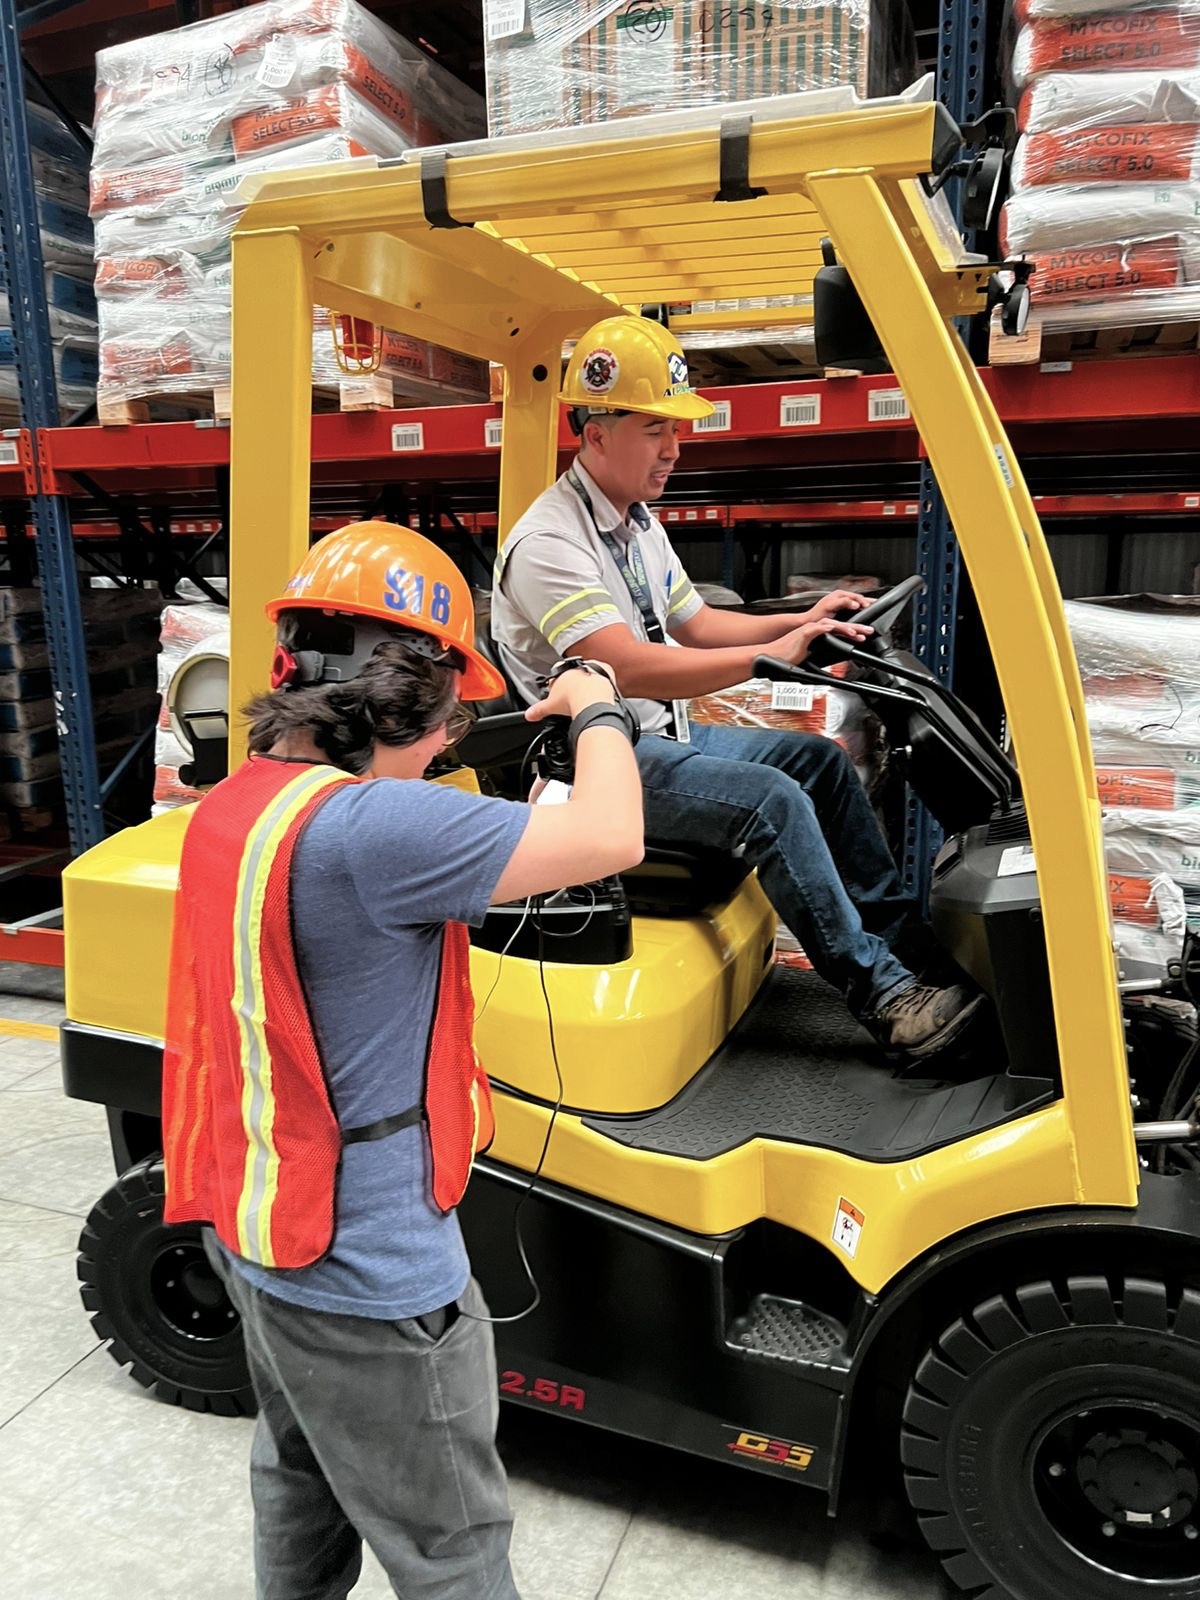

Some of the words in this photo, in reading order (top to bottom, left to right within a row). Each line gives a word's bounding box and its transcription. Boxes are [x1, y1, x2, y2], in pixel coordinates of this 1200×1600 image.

[1069, 17, 1158, 36] MYCOFIX
[1061, 42, 1129, 61] SELECT
[361, 75, 392, 109] SELECT
[252, 117, 294, 141] SELECT
[1062, 131, 1153, 149] MYCOFIX
[1055, 156, 1122, 174] SELECT
[1127, 155, 1155, 172] 5.0
[1043, 272, 1108, 295] SELECT
[1115, 271, 1142, 287] 5.0
[777, 686, 798, 696] 1,000
[798, 687, 809, 695] KG
